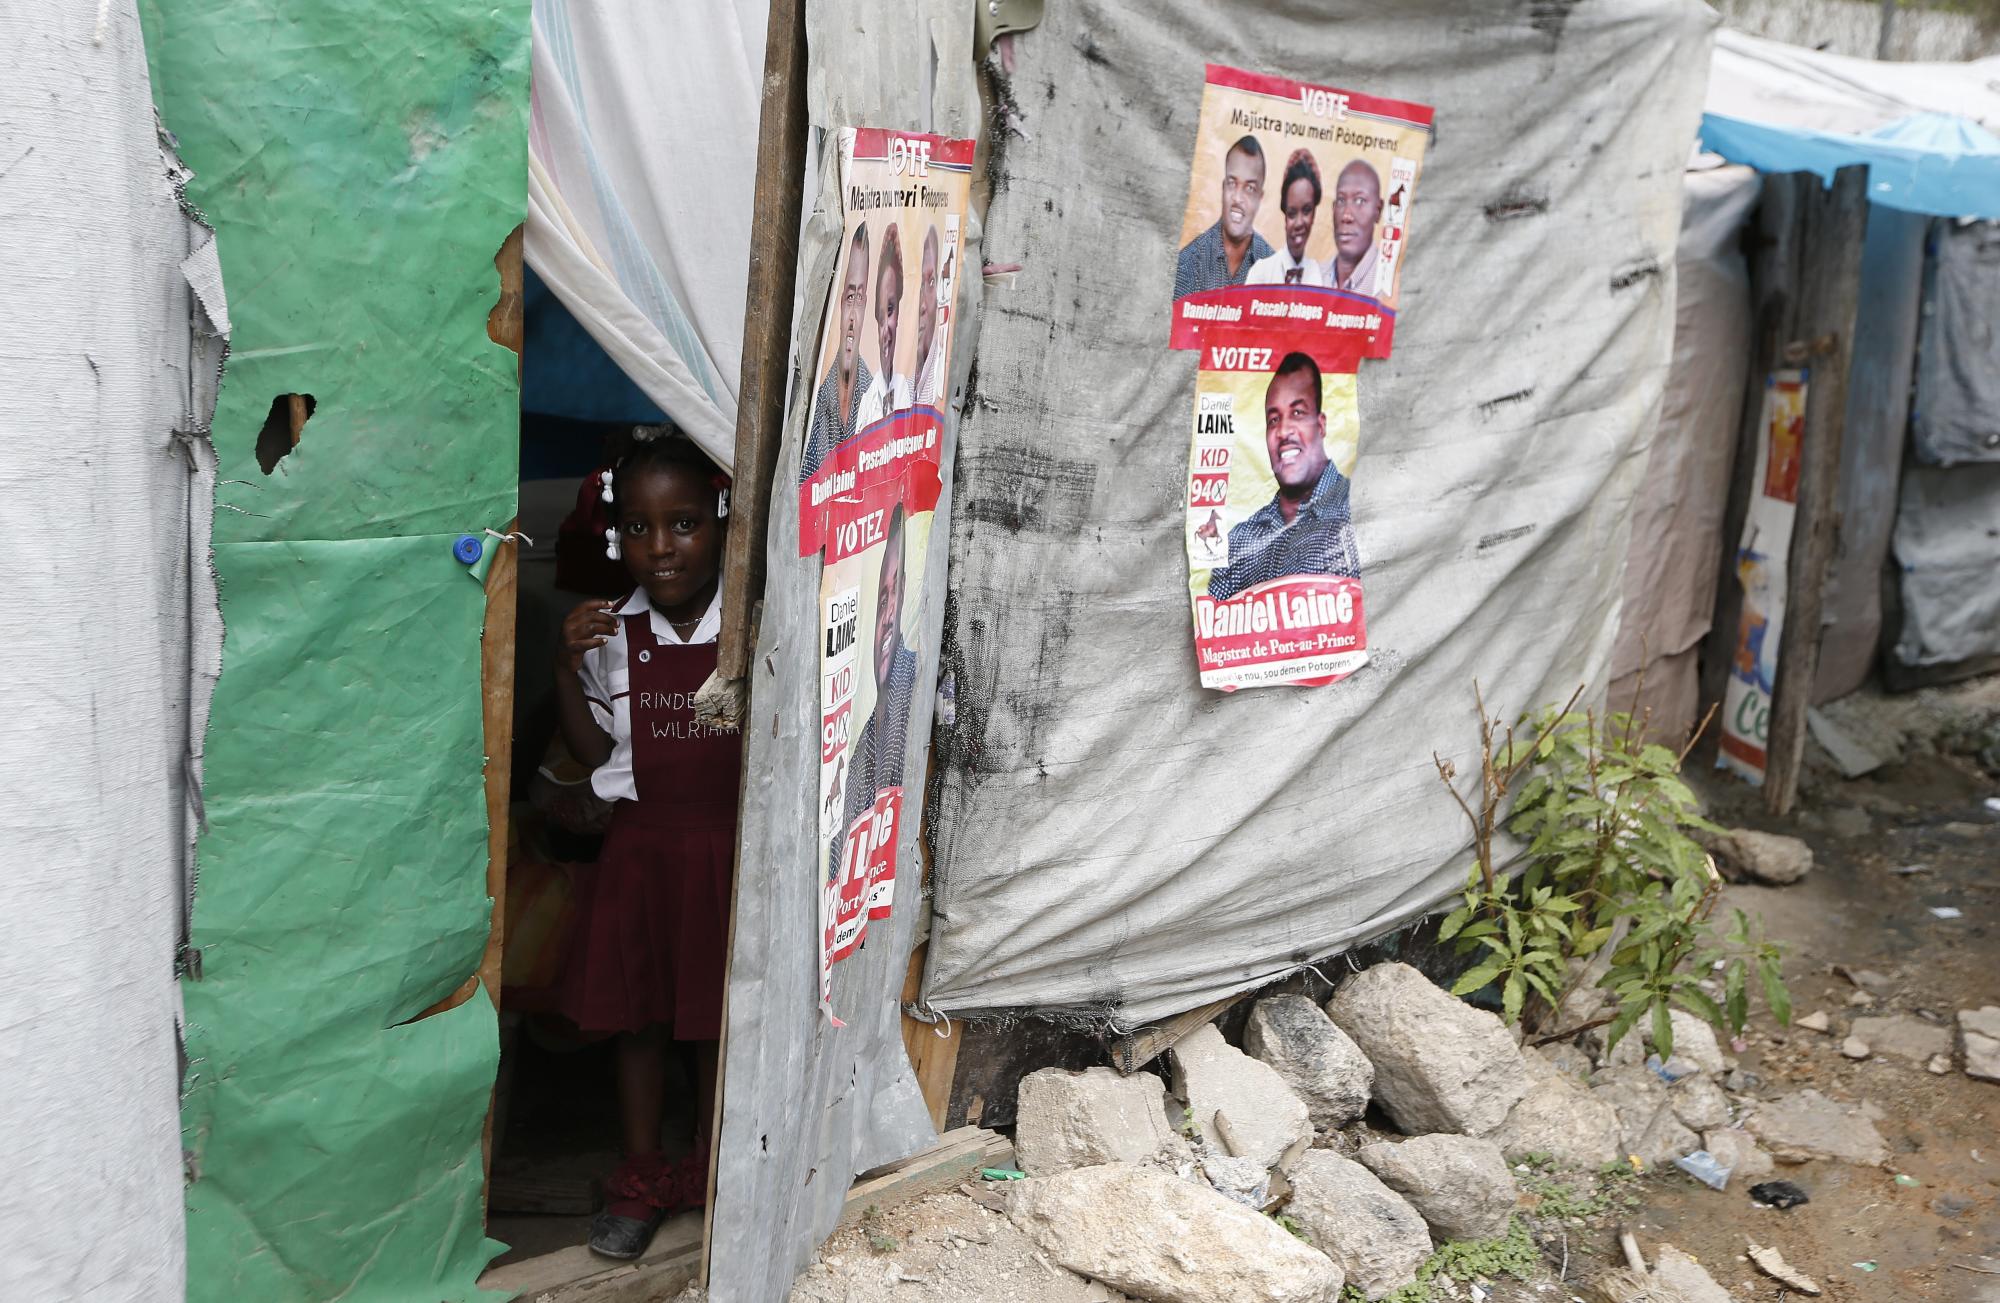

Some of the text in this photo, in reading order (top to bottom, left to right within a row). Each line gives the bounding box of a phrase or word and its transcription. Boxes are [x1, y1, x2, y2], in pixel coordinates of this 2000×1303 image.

[1300, 87, 1349, 121] VOTE
[1231, 108, 1282, 132] Majistra
[1285, 121, 1305, 138] pou
[1308, 125, 1334, 140] meri
[1182, 301, 1217, 321] Daniel
[1250, 299, 1288, 317] Pascale
[1325, 311, 1365, 330] Jacques
[1211, 346, 1273, 370] VOTEZ
[1197, 414, 1235, 434] LAINE
[1200, 448, 1230, 467] KID
[836, 508, 885, 556] VOTEZ
[1196, 584, 1354, 640] Daniel Lainé
[826, 615, 857, 658] LAINE
[1202, 632, 1356, 667] Magistrat de Port-au-Prince
[831, 667, 850, 704] KID
[1264, 670, 1279, 679] sou
[1280, 665, 1307, 676] demen
